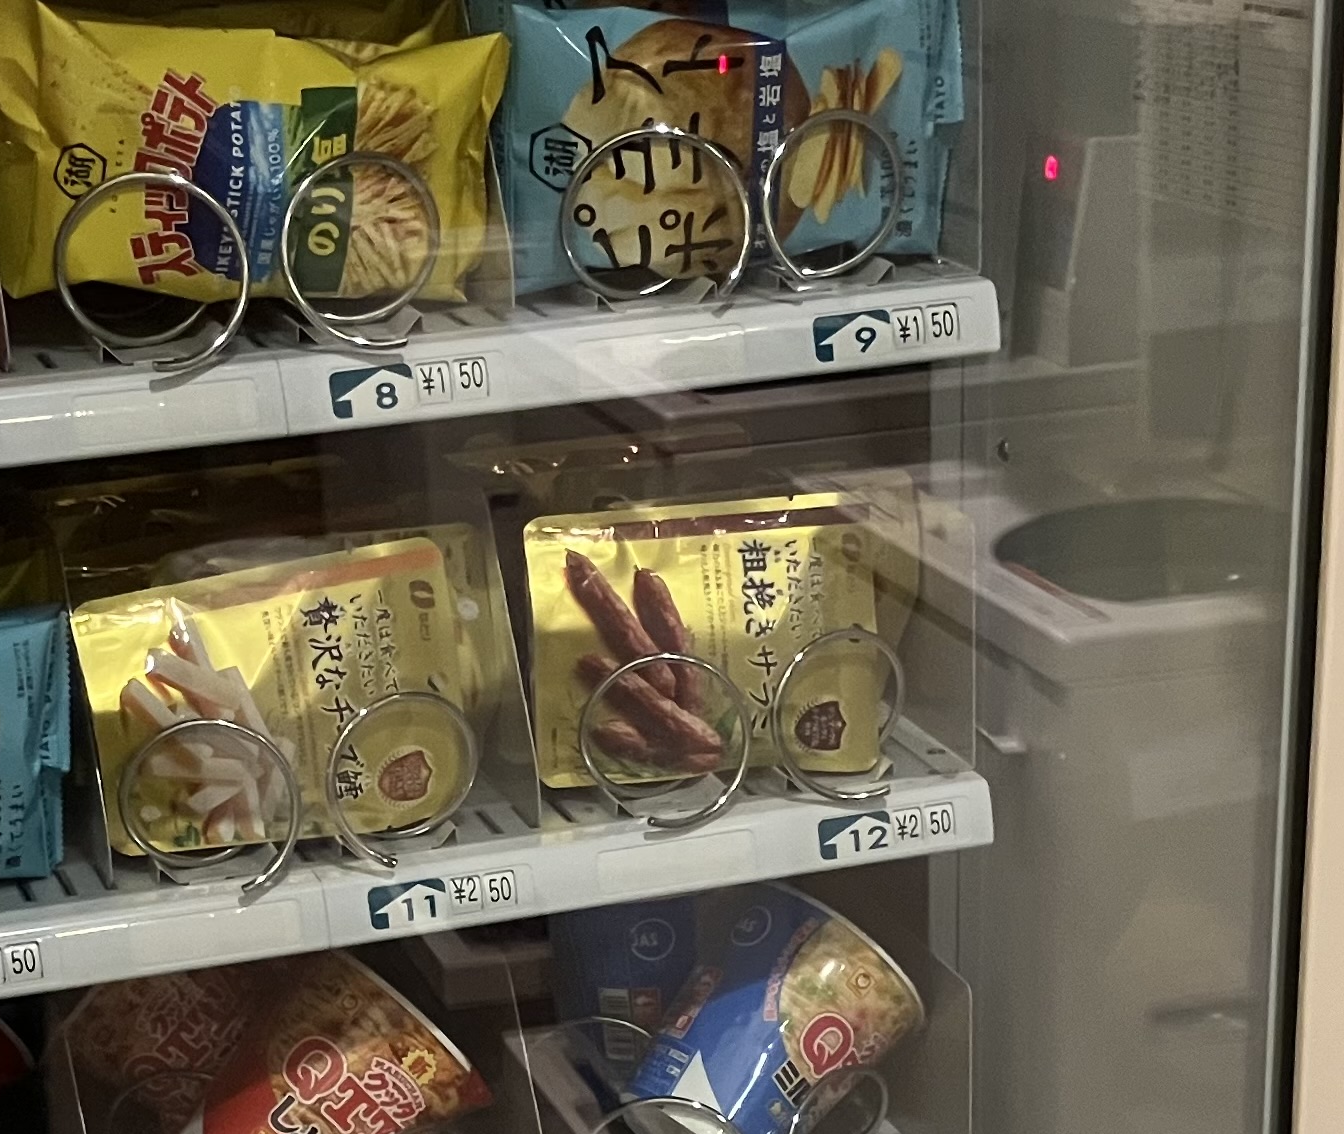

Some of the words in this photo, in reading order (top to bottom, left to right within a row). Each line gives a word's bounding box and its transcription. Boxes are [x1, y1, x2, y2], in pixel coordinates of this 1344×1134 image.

[854, 327, 877, 352] 9
[375, 382, 397, 409] 8
[783, 539, 803, 640] いただきたい
[349, 593, 375, 696] いただきたい
[374, 590, 400, 693] 一度は食べて
[737, 539, 779, 731] 粗挽きサラミ
[848, 826, 888, 852] 12
[402, 894, 439, 921] 11
